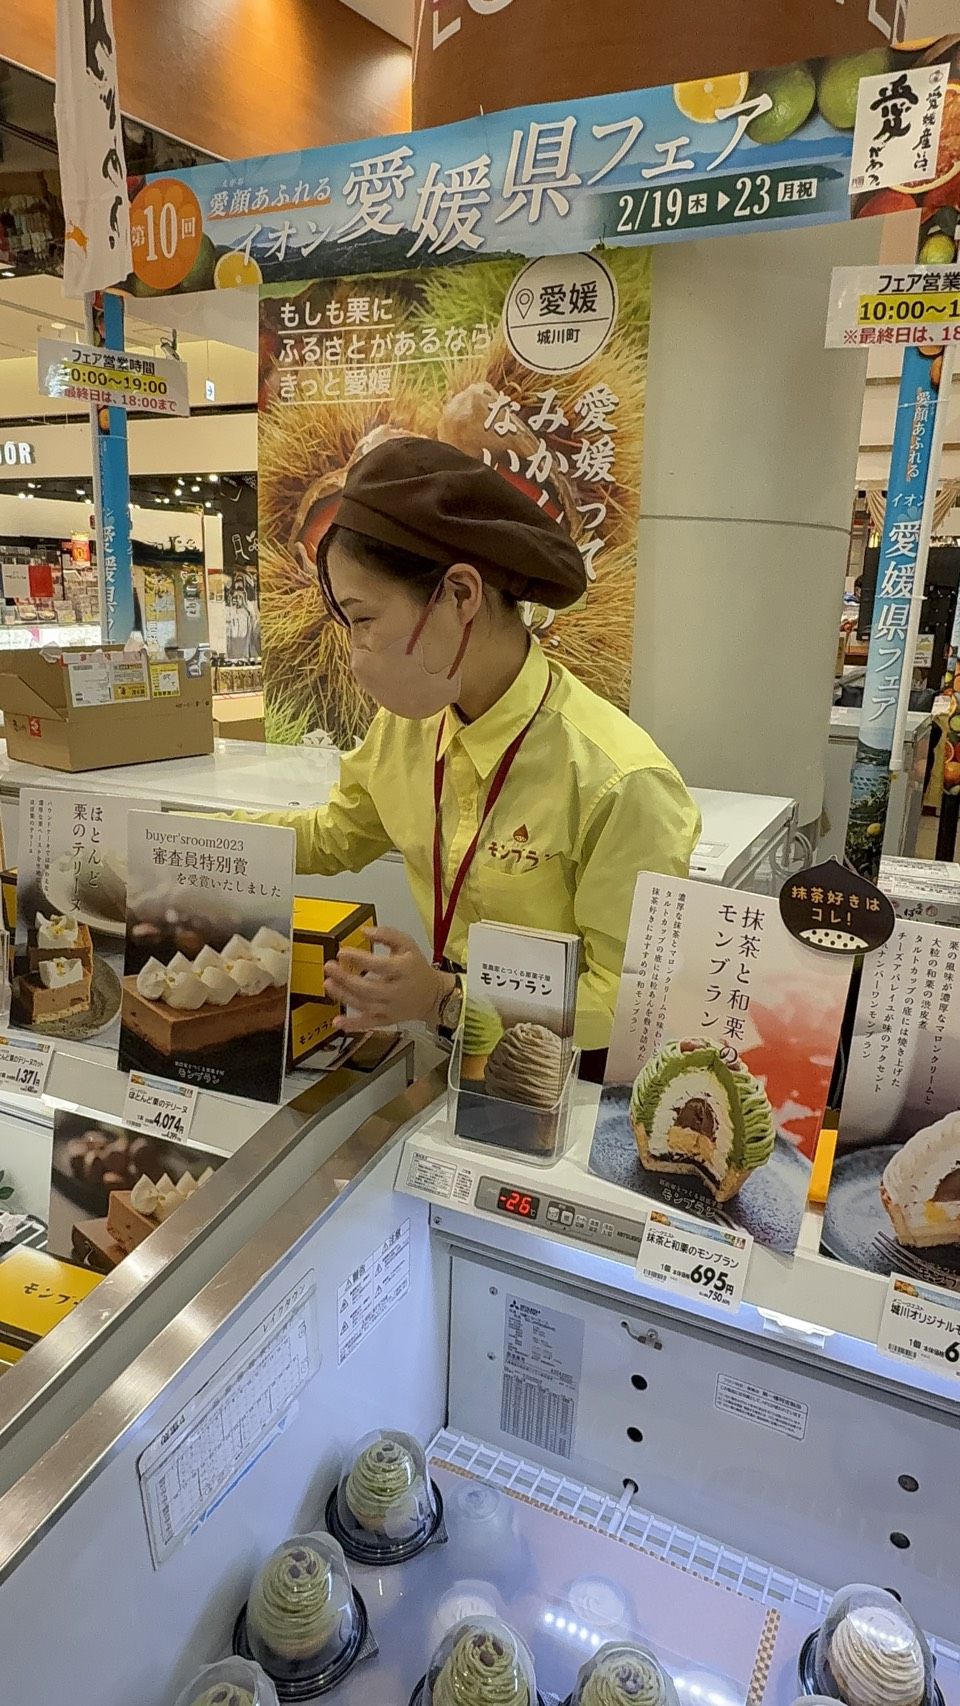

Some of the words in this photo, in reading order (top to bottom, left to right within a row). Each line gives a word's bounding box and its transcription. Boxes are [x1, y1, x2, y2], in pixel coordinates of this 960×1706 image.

[337, 93, 773, 258] 愛媛県フェア
[209, 176, 331, 217] 愛顔あふれる
[616, 199, 681, 233] 2/19
[688, 194, 707, 214] 木
[734, 175, 771, 218] 23
[131, 202, 196, 262] 第10回
[232, 220, 334, 267] イオン
[878, 271, 960, 293] フェア営業
[279, 297, 393, 328] もしも栗に
[538, 280, 599, 318] 愛媛
[279, 323, 492, 364] ふるさとがあるなら
[536, 328, 580, 345] 城川町
[71, 349, 156, 377] フェア営業時間
[66, 366, 168, 395] 0:00～19:00
[279, 368, 393, 397] きっと愛媛
[906, 391, 932, 480] 愛顔あふれる
[571, 383, 620, 583] 愛媛って
[868, 520, 921, 722] 愛媛県フェア
[88, 806, 104, 888] ほとんど
[145, 829, 244, 852] buyer'sroom2023
[488, 841, 558, 867] モンブラン
[71, 803, 88, 912] 栗のテリーヌ
[152, 847, 249, 877] 審査員特別賞
[176, 872, 282, 898] を受賞いたしました
[791, 885, 881, 912] 抹茶好きは
[701, 904, 738, 1028] モンブラン
[480, 972, 553, 996] モンブラン
[719, 905, 766, 1065] 抹茶と和栗の
[299, 1016, 335, 1045] モンブラ
[662, 1187, 716, 1218] モンブラン
[646, 1233, 740, 1268] 抹茶と和栗のモンブラン
[24, 1282, 83, 1306] モンブ
